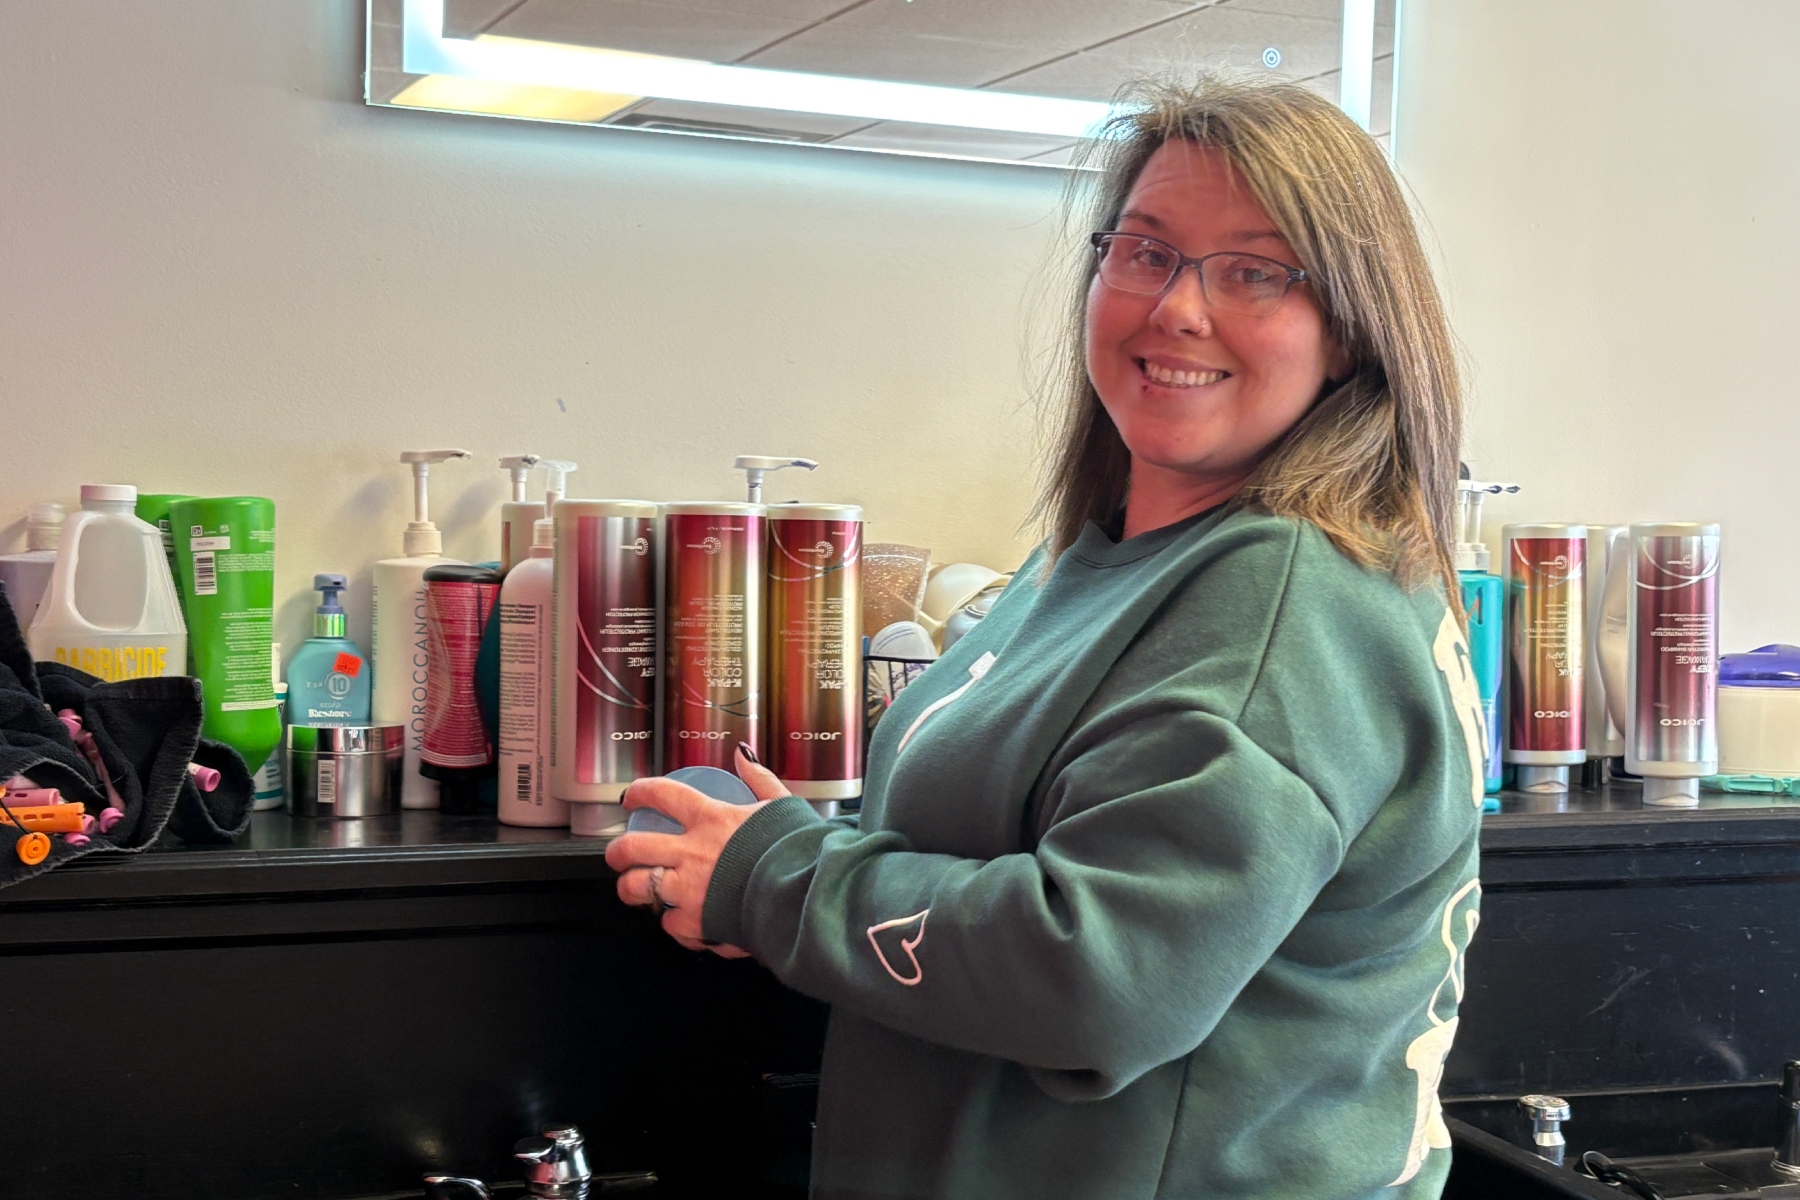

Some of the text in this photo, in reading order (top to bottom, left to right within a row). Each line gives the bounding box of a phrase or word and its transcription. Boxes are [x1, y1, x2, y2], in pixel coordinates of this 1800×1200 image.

[691, 657, 743, 667] THERAPY
[702, 668, 743, 677] COLOR
[814, 669, 843, 679] OLOR
[332, 677, 347, 692] 10
[705, 678, 742, 688] K-PAK
[818, 680, 846, 689] -PAK
[1659, 718, 1706, 726] JOICO
[610, 731, 653, 741] JOICO
[678, 730, 731, 740] JOICO
[789, 731, 842, 741] JOICO
